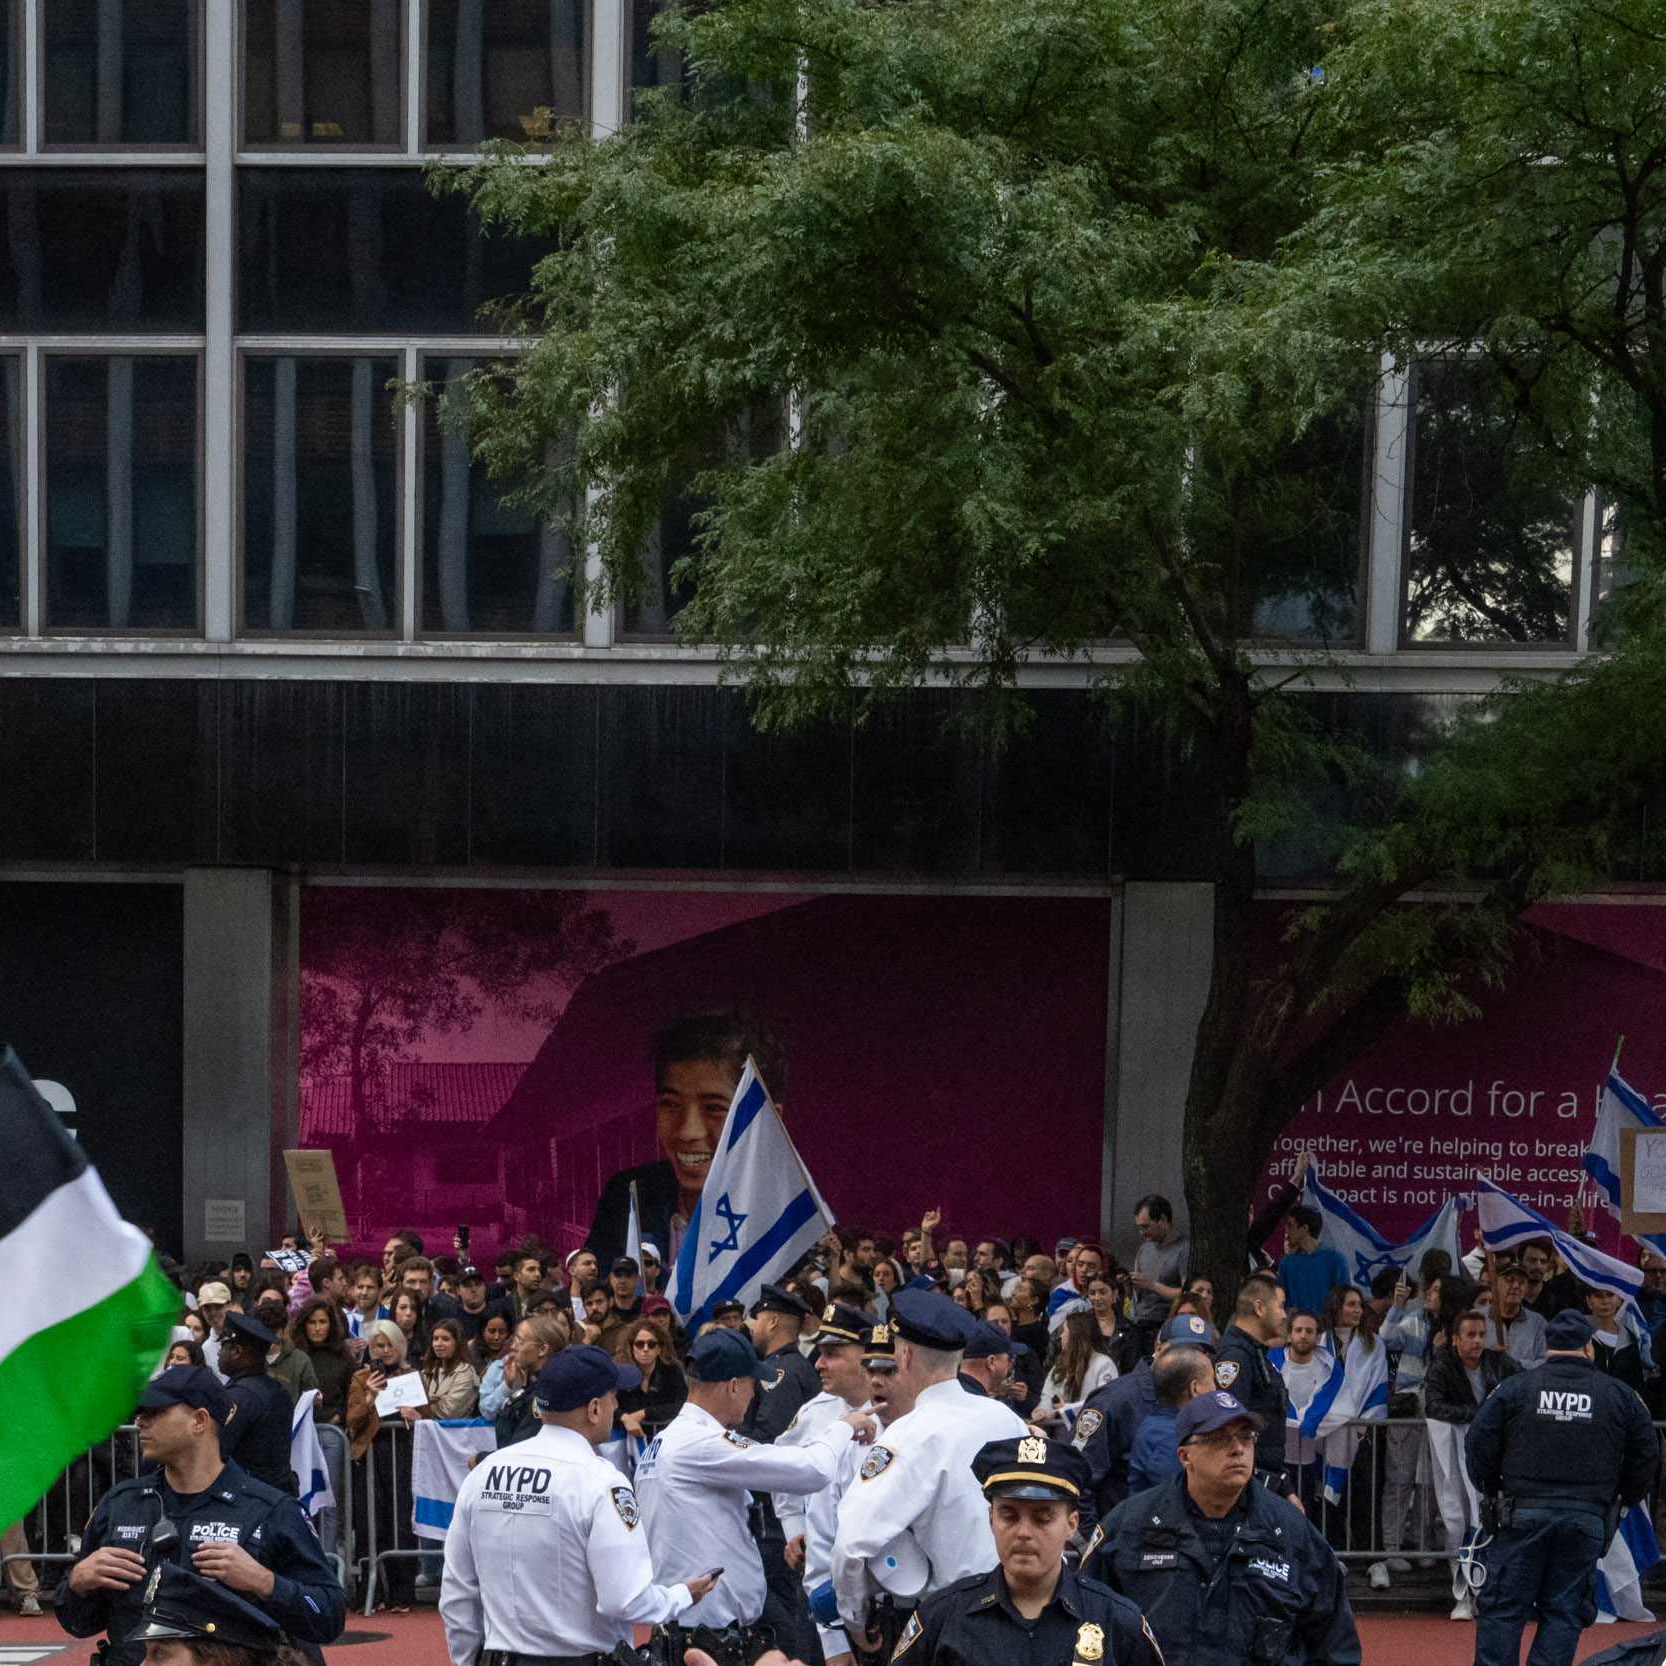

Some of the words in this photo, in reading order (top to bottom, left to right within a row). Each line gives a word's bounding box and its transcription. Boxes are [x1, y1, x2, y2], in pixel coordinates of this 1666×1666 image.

[1336, 1079, 1474, 1117] Accord
[1487, 1081, 1546, 1119] for
[1557, 1096, 1579, 1120] a
[1369, 1136, 1423, 1154] we're
[1430, 1136, 1502, 1161] helping
[1509, 1139, 1529, 1156] to
[1373, 1160, 1408, 1179] and
[1414, 1160, 1522, 1182] sustainable
[1382, 1187, 1395, 1203] is
[1400, 1187, 1437, 1205] not
[1540, 1390, 1592, 1413] NYPD
[485, 1466, 552, 1496] NYPD
[481, 1492, 515, 1503] STRATEGIC
[516, 1494, 551, 1505] RESPONSE
[502, 1502, 525, 1512] GROUP
[192, 1524, 240, 1540] POLICE
